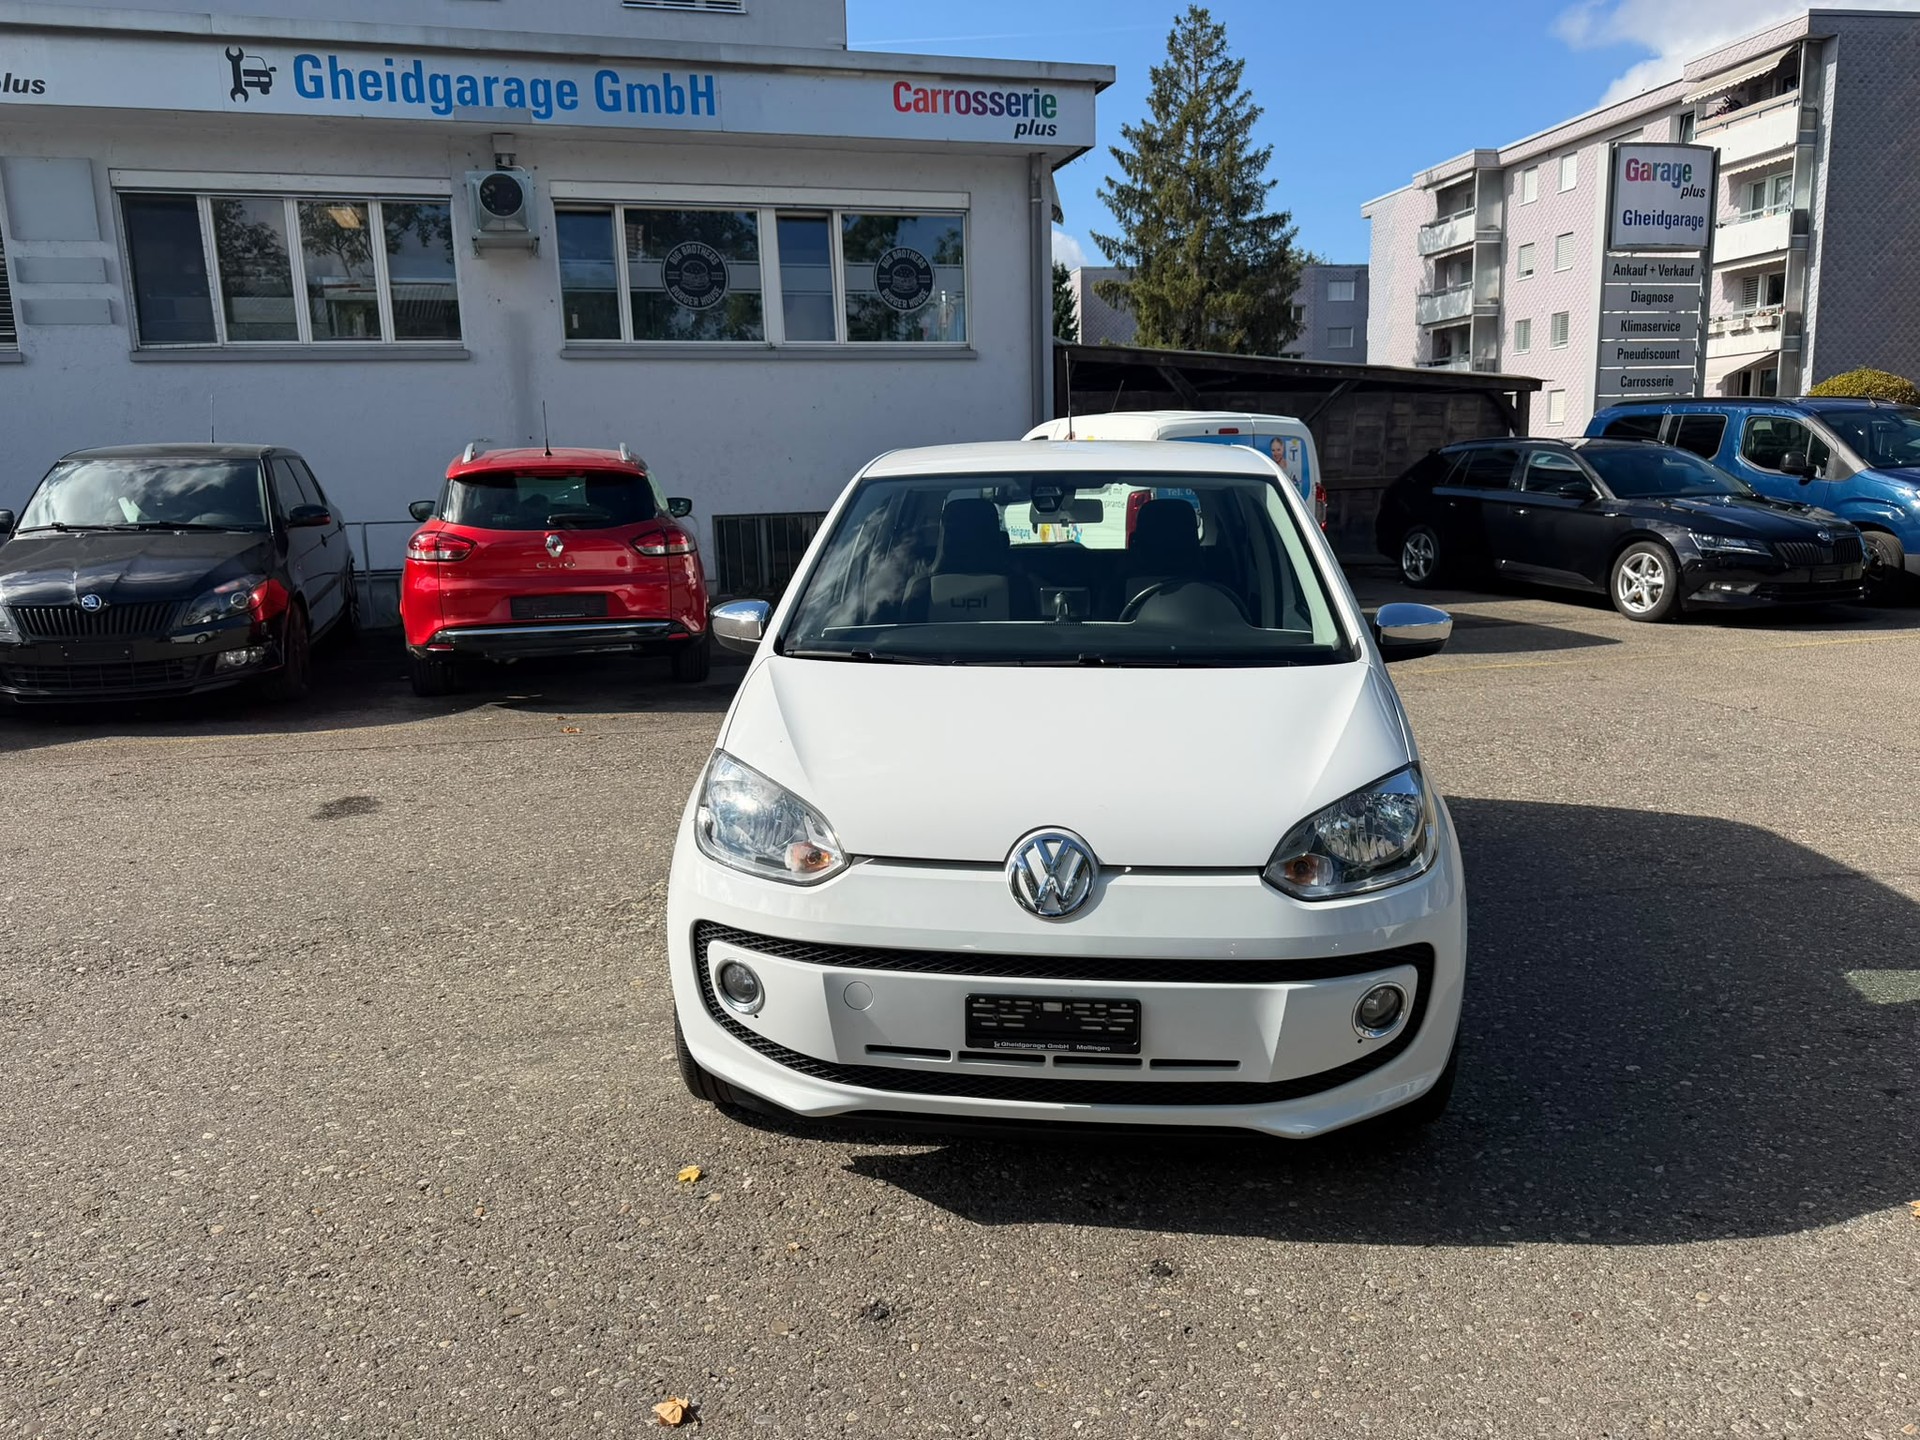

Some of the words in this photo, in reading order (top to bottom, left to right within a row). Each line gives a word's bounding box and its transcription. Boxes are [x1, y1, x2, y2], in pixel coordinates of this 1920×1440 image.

[0, 73, 46, 95] lus
[293, 53, 579, 119] Gheidgarage
[594, 69, 717, 117] GmbH
[893, 81, 1057, 119] Carrosserie
[1014, 119, 1057, 139] plus
[1625, 158, 1692, 189] Garage
[1680, 184, 1706, 200] plus
[1622, 209, 1704, 231] Gheidgarage
[669, 250, 683, 265] BIG
[681, 244, 720, 266] BROTHERS
[892, 249, 927, 269] BROTHERS
[1613, 263, 1649, 277] Ankauf
[1649, 266, 1656, 275] +
[1658, 264, 1695, 277] Verkauf
[670, 284, 699, 307] BURGER
[699, 285, 723, 306] HOUSE
[881, 288, 908, 309] BURGER
[908, 288, 929, 308] HOUSE
[1631, 291, 1674, 305] Diagnose
[1620, 319, 1681, 333] Klimaservice
[1617, 347, 1680, 361] Pneudiscount
[1620, 375, 1674, 388] Carrosserie
[536, 561, 576, 569] CLIO
[950, 594, 988, 613] up!
[1008, 829, 1097, 919] VW
